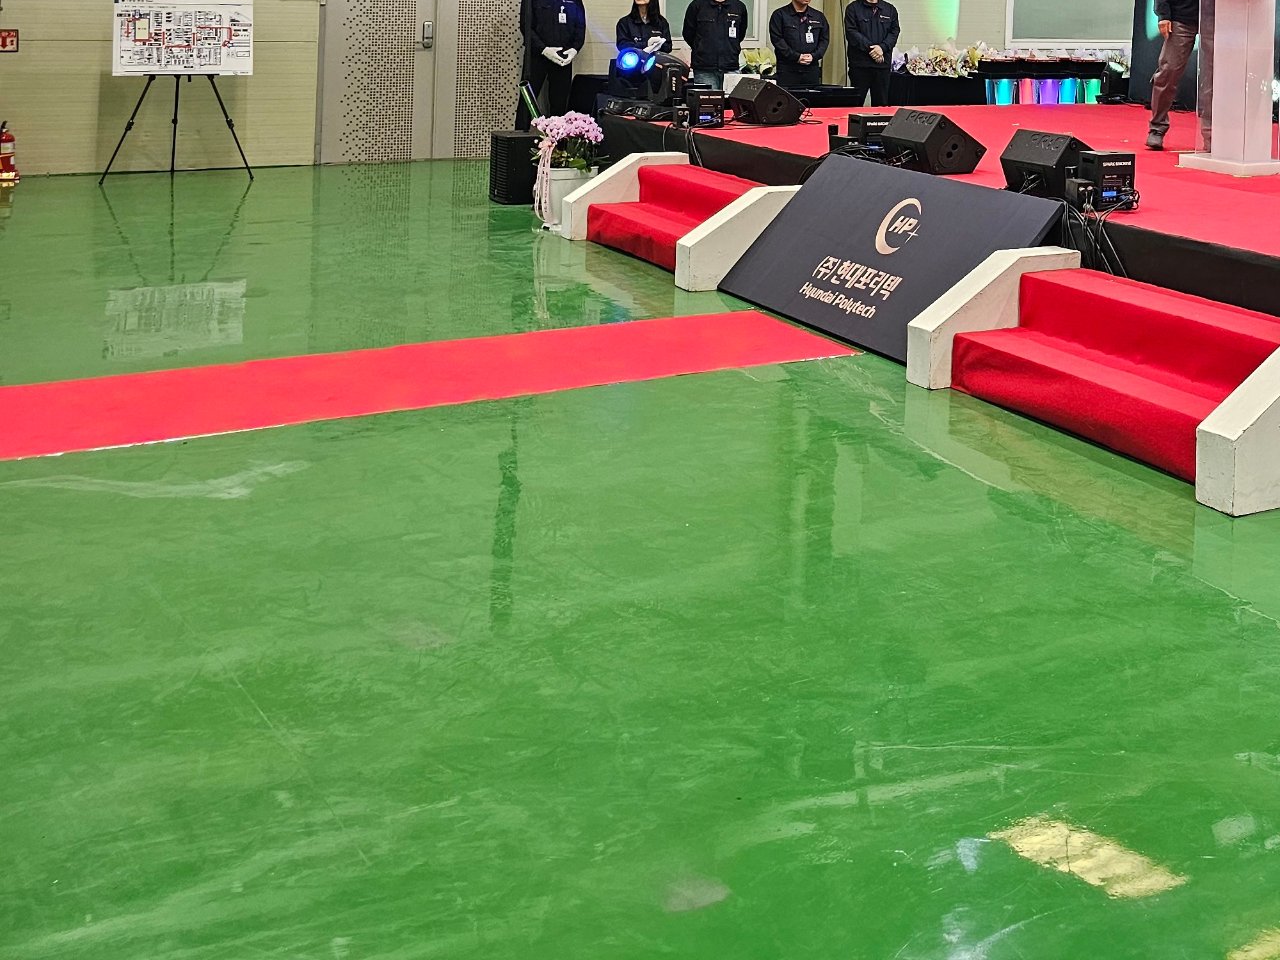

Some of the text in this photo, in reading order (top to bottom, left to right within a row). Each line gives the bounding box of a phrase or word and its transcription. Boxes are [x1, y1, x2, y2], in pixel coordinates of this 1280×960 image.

[812, 255, 903, 300] (주)현대포리텍
[799, 281, 877, 319] Hyundai Polytech
